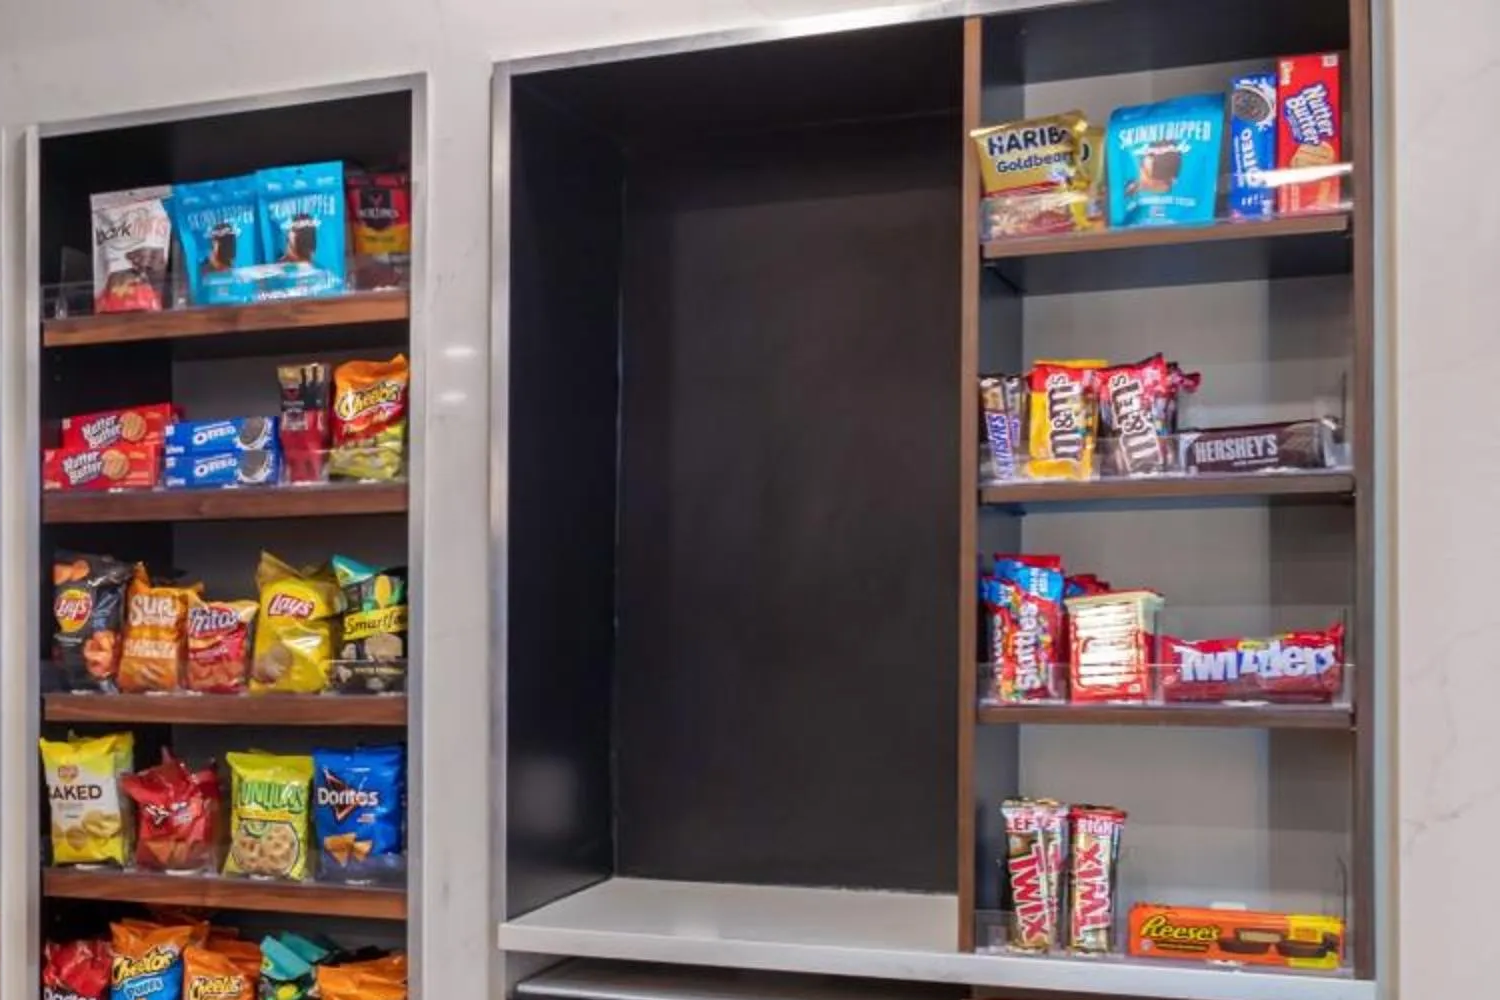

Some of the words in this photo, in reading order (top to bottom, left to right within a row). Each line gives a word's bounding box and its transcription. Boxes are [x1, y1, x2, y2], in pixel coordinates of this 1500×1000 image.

[987, 126, 1069, 155] HARIB
[1195, 434, 1277, 463] HERSHEY'S
[316, 787, 380, 806] Doritos
[1008, 844, 1048, 941] TWIX
[1072, 843, 1110, 938] TWIX
